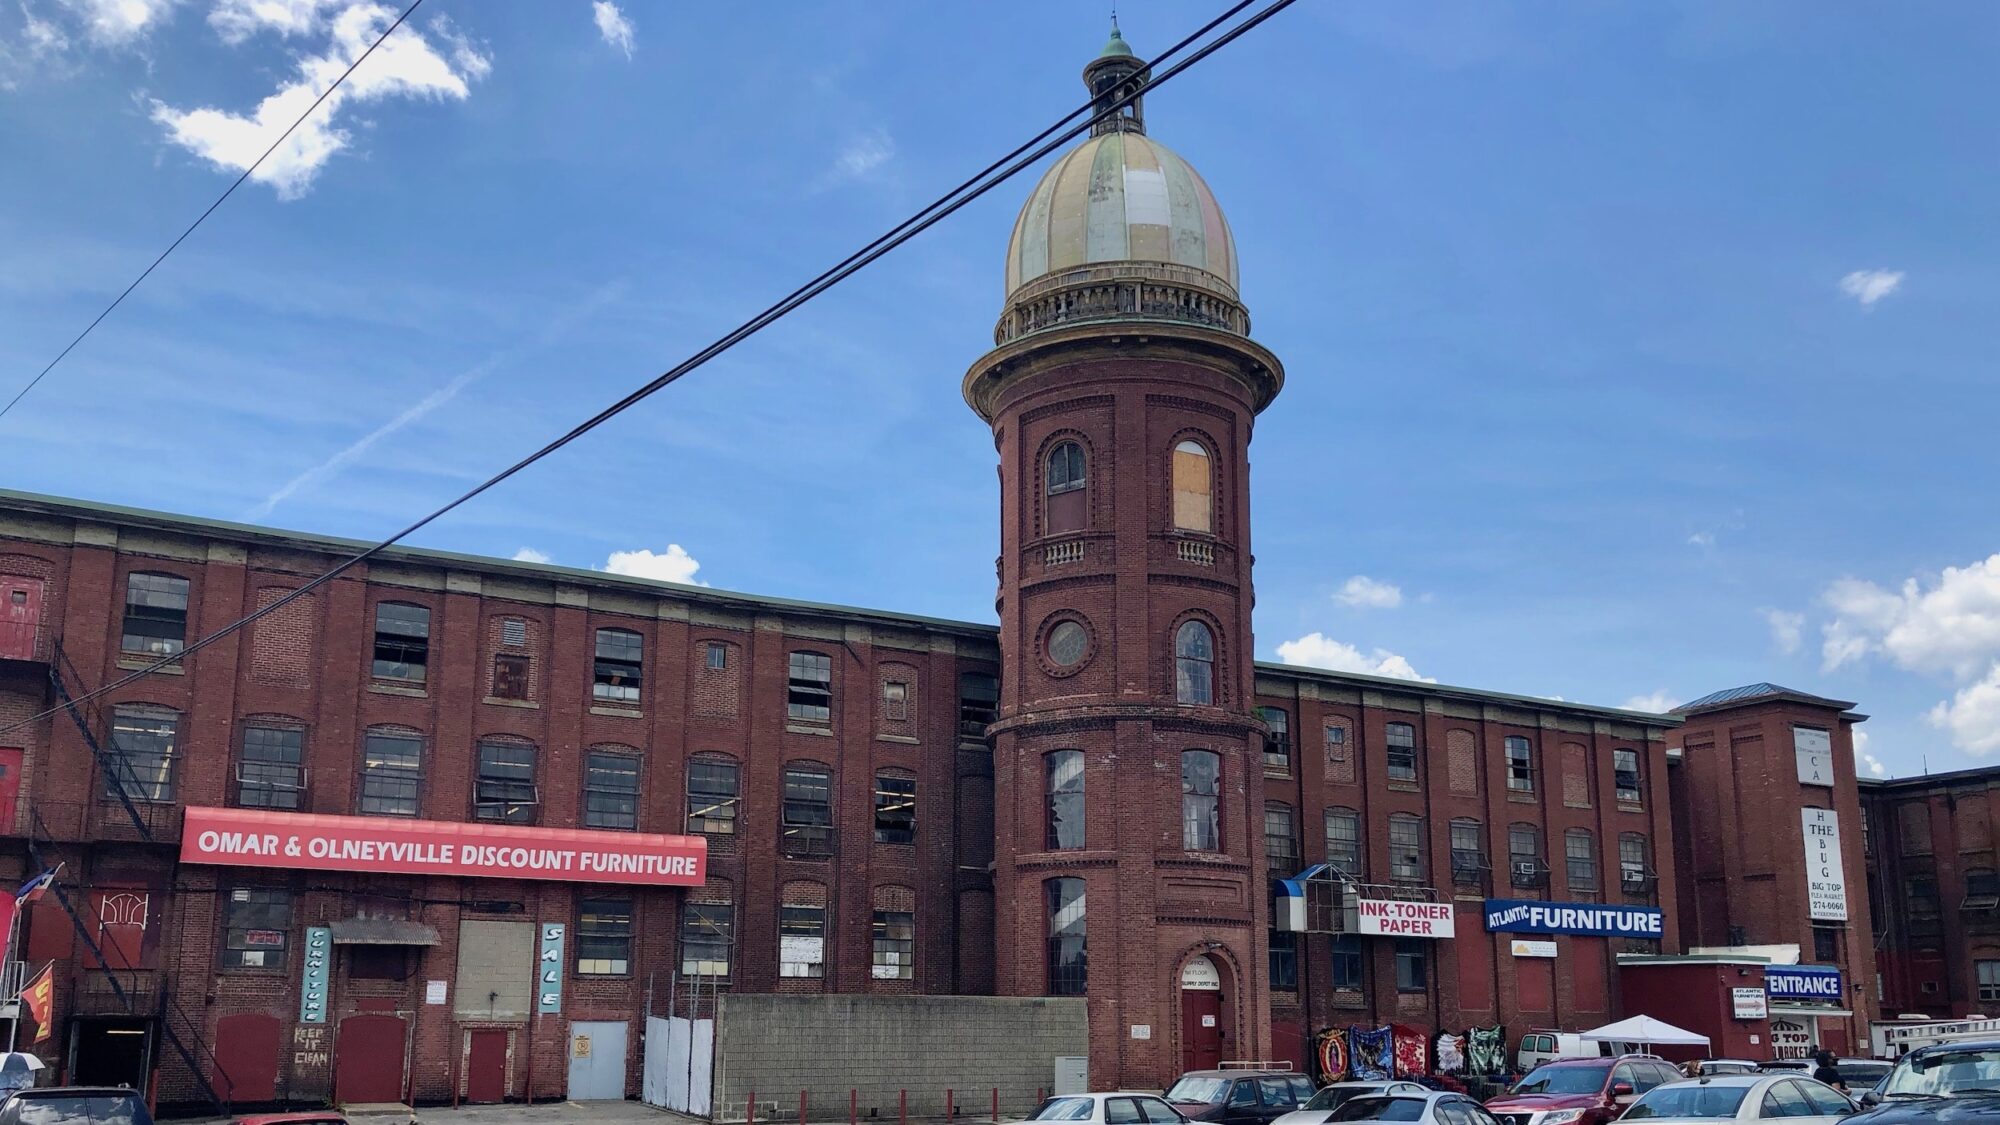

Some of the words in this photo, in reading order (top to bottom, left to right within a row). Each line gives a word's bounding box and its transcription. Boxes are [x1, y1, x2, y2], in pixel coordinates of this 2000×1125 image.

[1809, 824, 1834, 836] THE
[198, 830, 279, 855] OMAR
[284, 836, 302, 857] &
[308, 837, 455, 864] OLNEYVILLE
[461, 845, 576, 870] DISCOUNT
[579, 851, 697, 875] FURNITURE
[1811, 882, 1824, 891] BIG
[1826, 883, 1842, 892] TOP
[1360, 902, 1450, 920] INK-TONER
[1812, 901, 1844, 911] 274-0060
[1380, 919, 1432, 934] PAPER
[1489, 905, 1530, 929] ATLANTIC
[1530, 907, 1662, 933] FURNITURE
[541, 928, 563, 1006] SALE
[305, 930, 324, 1021] FURNITURE
[1770, 975, 1839, 995] ENTRANCE
[294, 1028, 323, 1043] KEEP
[1782, 1033, 1809, 1043] TOP
[305, 1039, 320, 1050] IT
[295, 1052, 327, 1066] CLEAN
